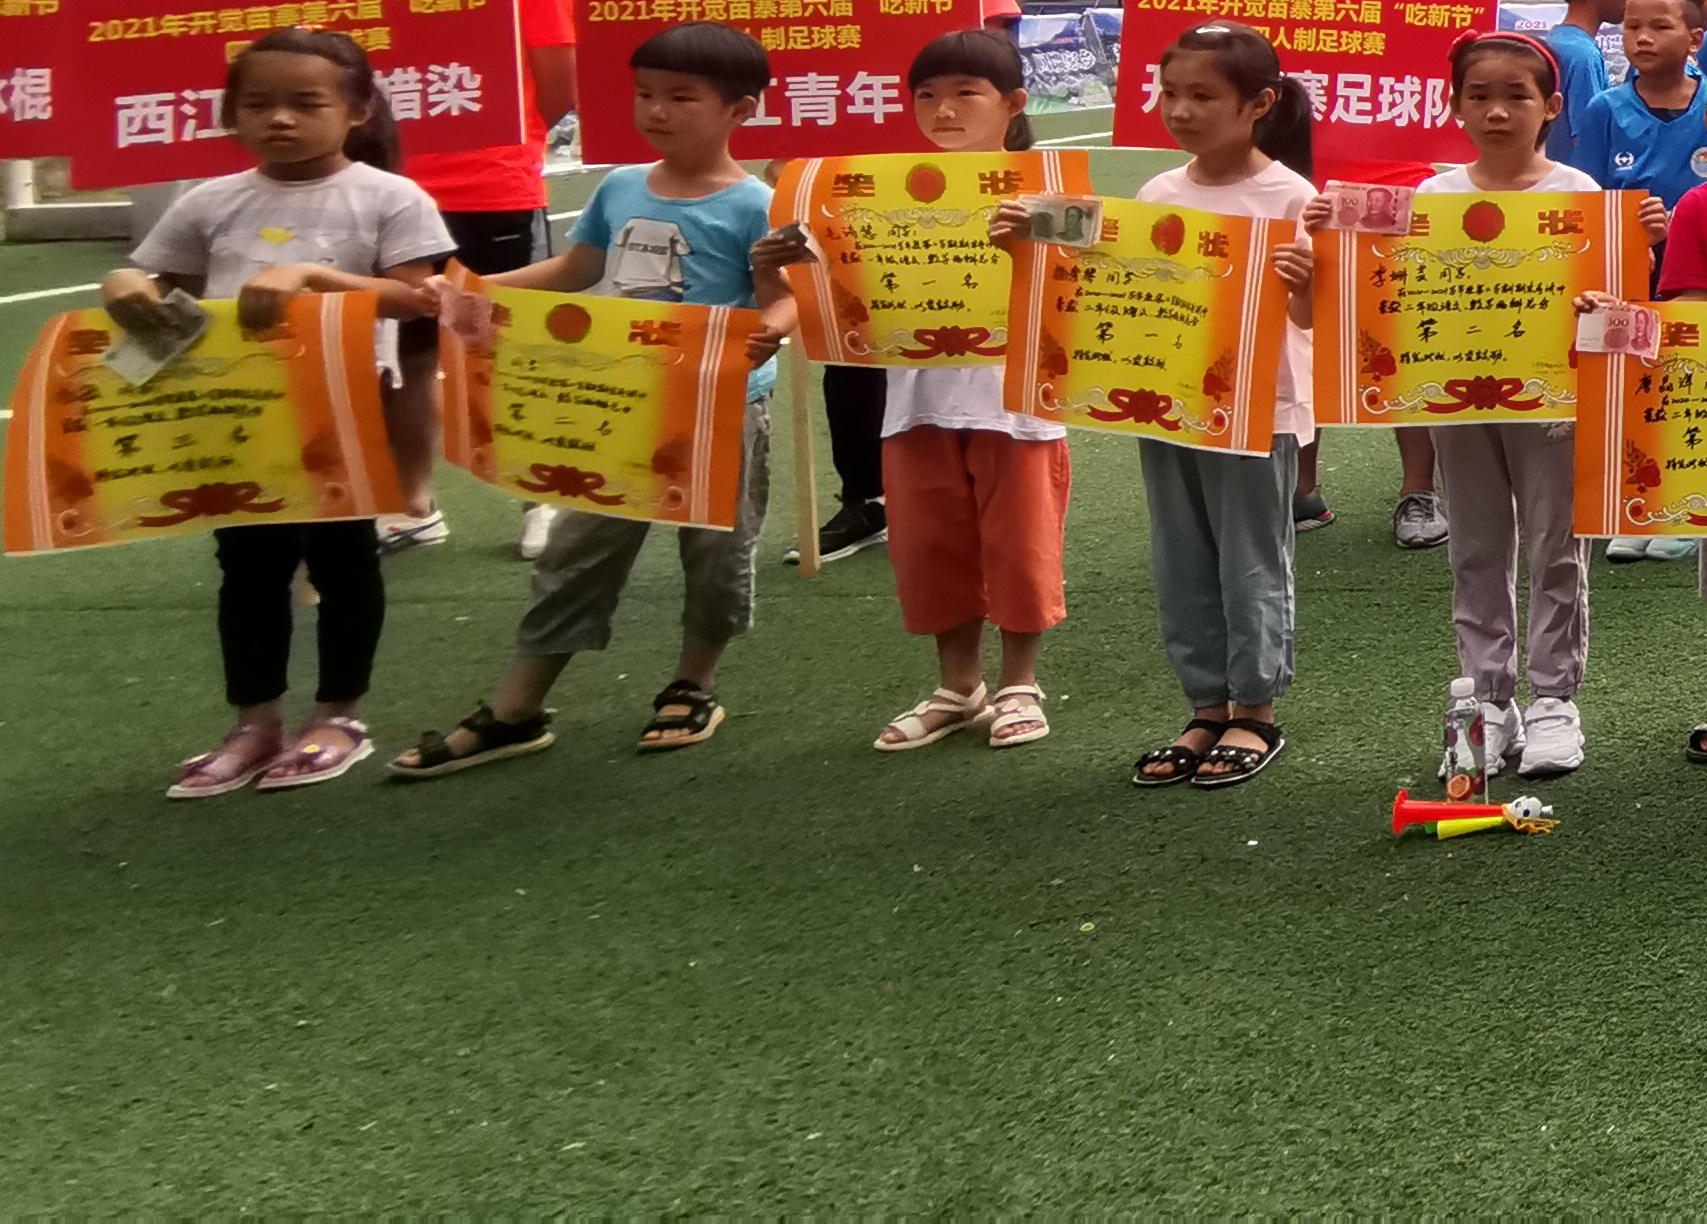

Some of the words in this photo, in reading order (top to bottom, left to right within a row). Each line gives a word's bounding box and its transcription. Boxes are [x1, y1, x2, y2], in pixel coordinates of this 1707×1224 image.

[1394, 1, 1485, 29] “吃新节”
[742, 23, 862, 52] 制足球赛
